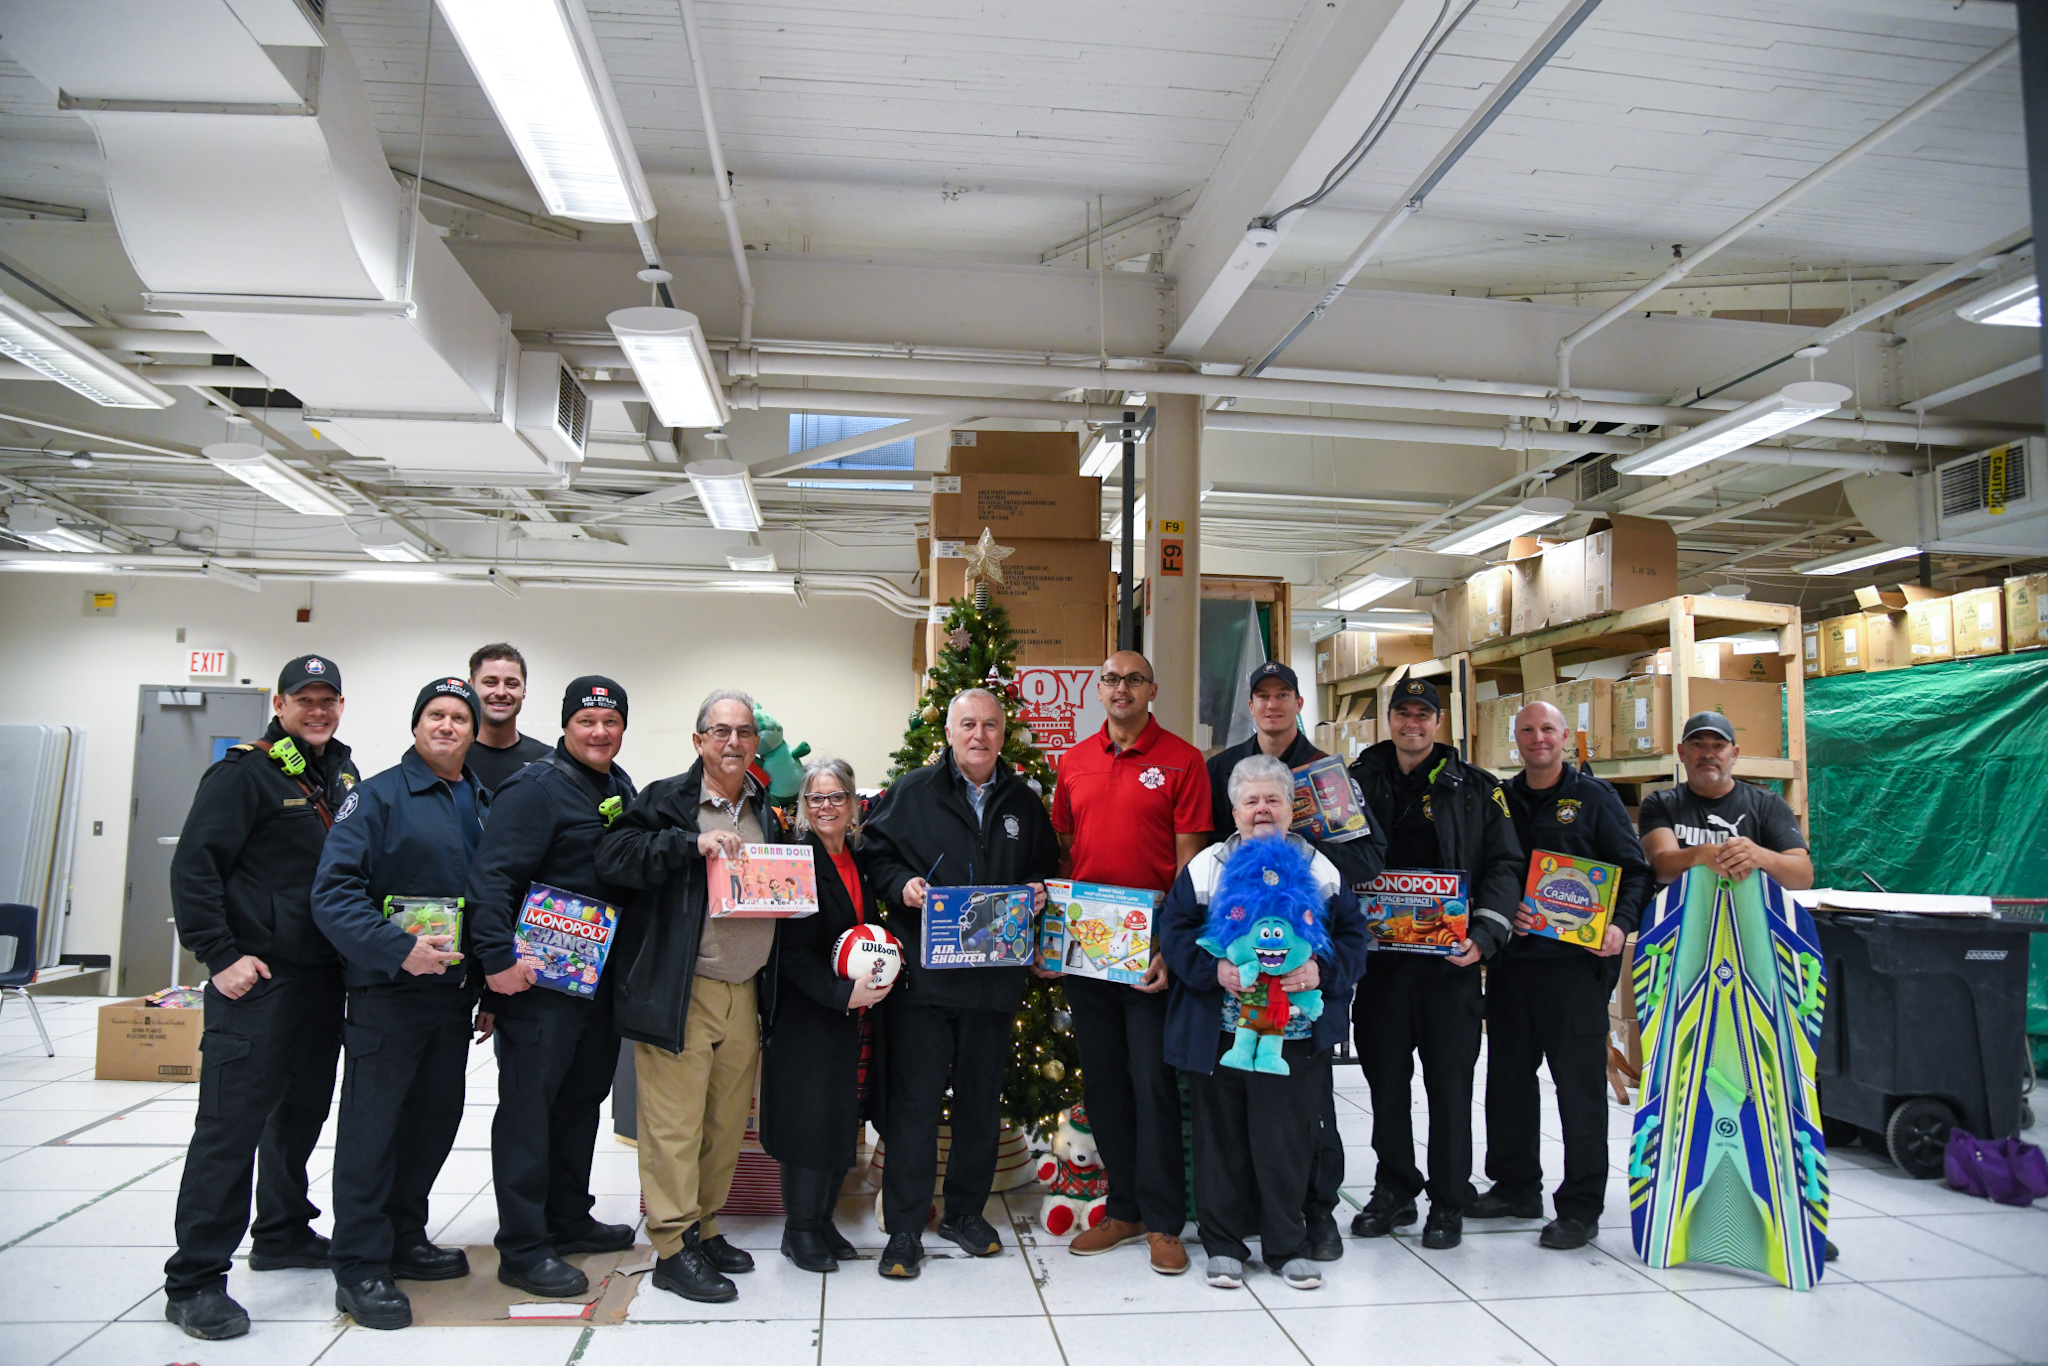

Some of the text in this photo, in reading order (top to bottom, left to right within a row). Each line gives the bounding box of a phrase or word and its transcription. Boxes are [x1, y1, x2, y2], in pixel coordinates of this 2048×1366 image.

[1991, 456, 2004, 508] CAUTION
[1166, 522, 1179, 532] F9
[1163, 545, 1181, 571] F9
[190, 652, 224, 672] EXIT
[582, 696, 617, 705] BELLEVILLE
[1674, 824, 1729, 846] PUMA
[750, 846, 811, 856] CHARM DOLLY
[1356, 876, 1455, 894] MONOPOLY
[1405, 896, 1430, 905] ESPACE
[527, 909, 607, 940] MONOPOLY
[527, 927, 596, 956] CHANCE
[862, 942, 897, 956] Wilson
[932, 945, 955, 954] AIR
[931, 954, 986, 964] SHOOTER
